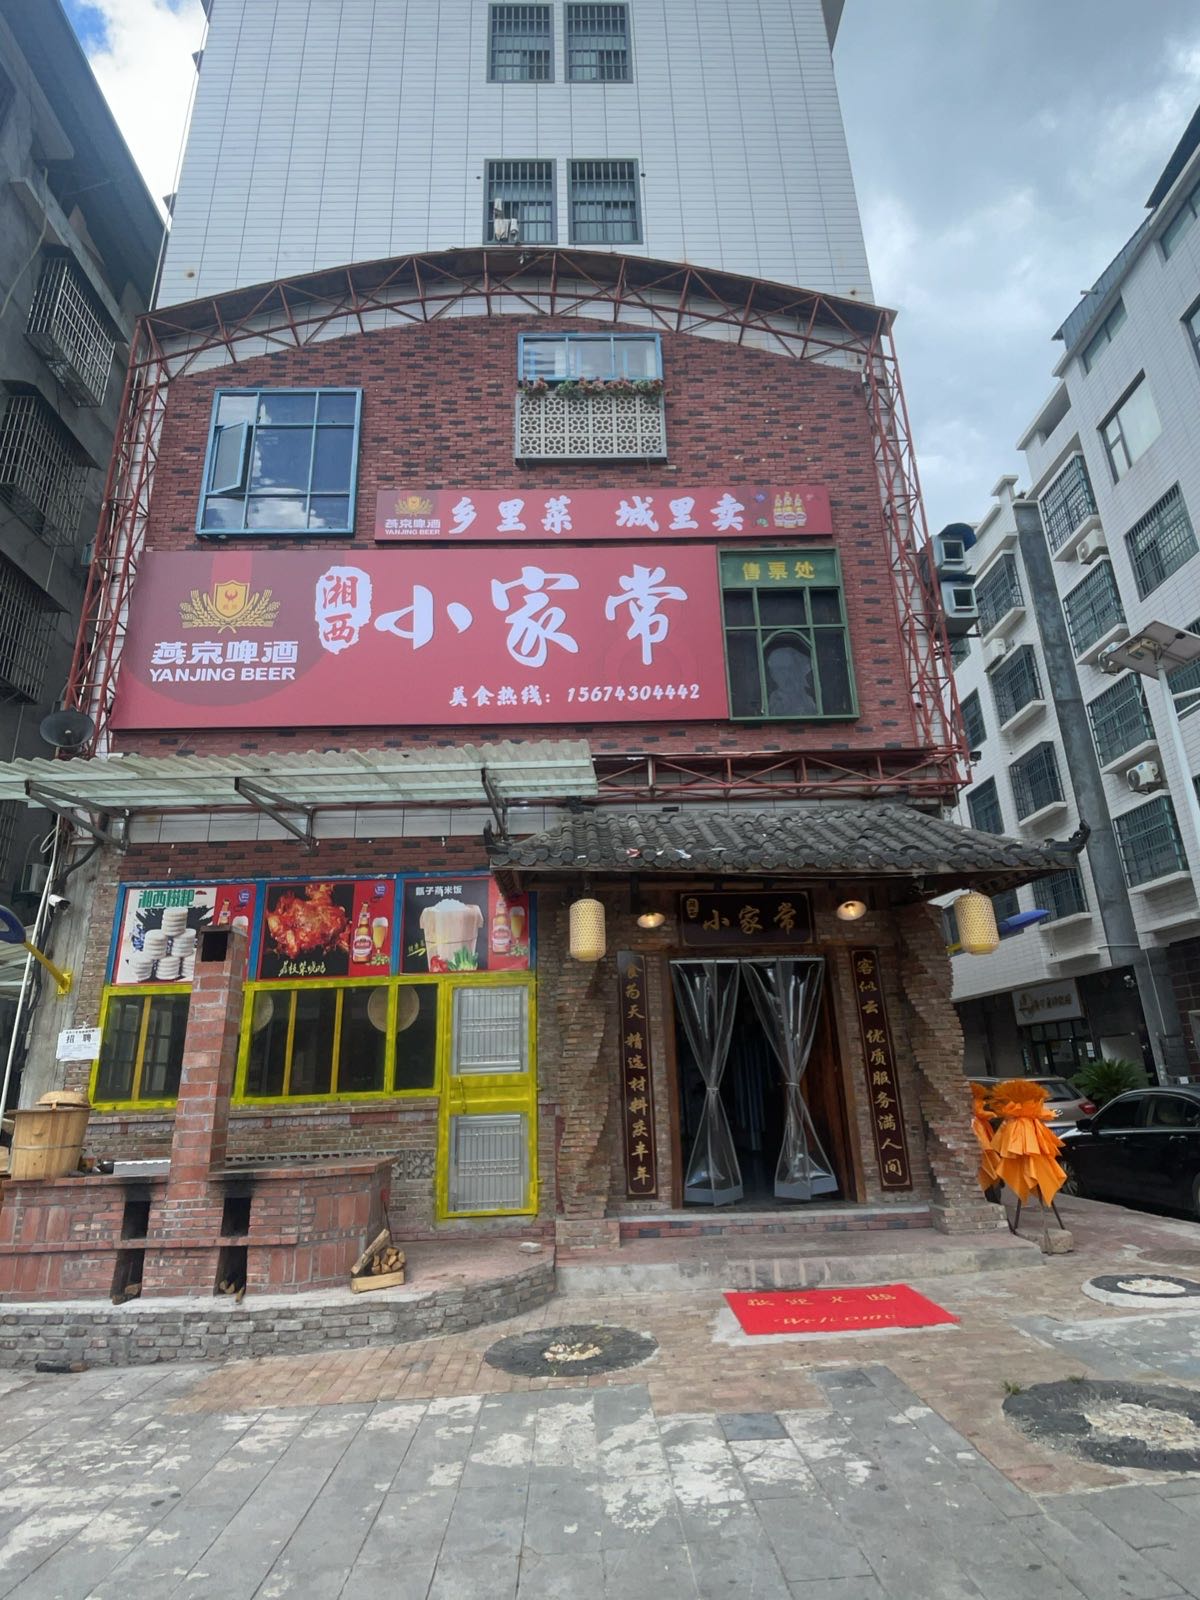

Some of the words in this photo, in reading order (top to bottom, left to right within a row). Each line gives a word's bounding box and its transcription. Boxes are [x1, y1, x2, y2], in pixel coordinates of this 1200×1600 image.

[384, 519, 441, 529] 燕京啤酒
[448, 495, 573, 535] 乡里菜
[615, 493, 745, 532] 城里卖
[743, 561, 816, 581] 售票处
[322, 574, 358, 644] 湘西
[374, 563, 688, 668] 小家常
[151, 640, 299, 665] 燕京啤酒
[150, 668, 236, 683] YANJING
[240, 667, 296, 682] BEER
[567, 683, 700, 703] 15674304442
[702, 901, 797, 935] 小家常
